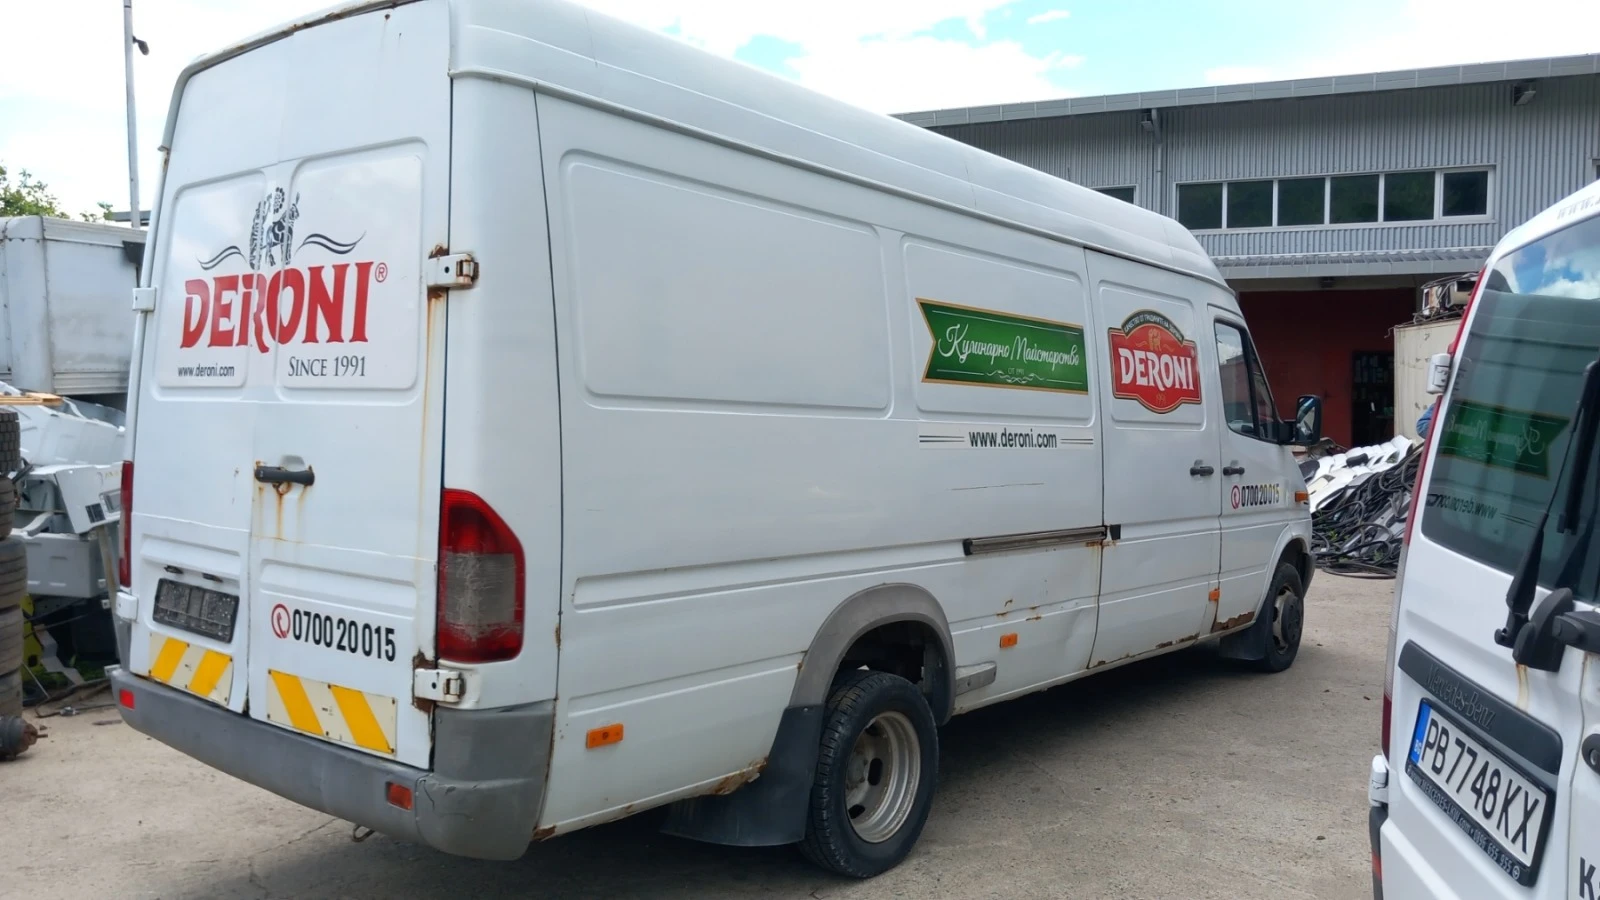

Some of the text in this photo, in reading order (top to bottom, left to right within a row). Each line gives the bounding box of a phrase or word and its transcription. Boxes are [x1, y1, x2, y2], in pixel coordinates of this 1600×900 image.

[179, 261, 374, 353] DERONI
[937, 323, 1010, 365] Кулинарно
[177, 362, 235, 378] www.deroni.com
[287, 355, 367, 377] SINCE 1991
[1118, 347, 1195, 391] DERONI
[968, 427, 1058, 448] www.deroni.com
[1424, 663, 1497, 731] Mercedes-Benz
[1445, 737, 1501, 820] 7748
[1496, 778, 1540, 854] KX
